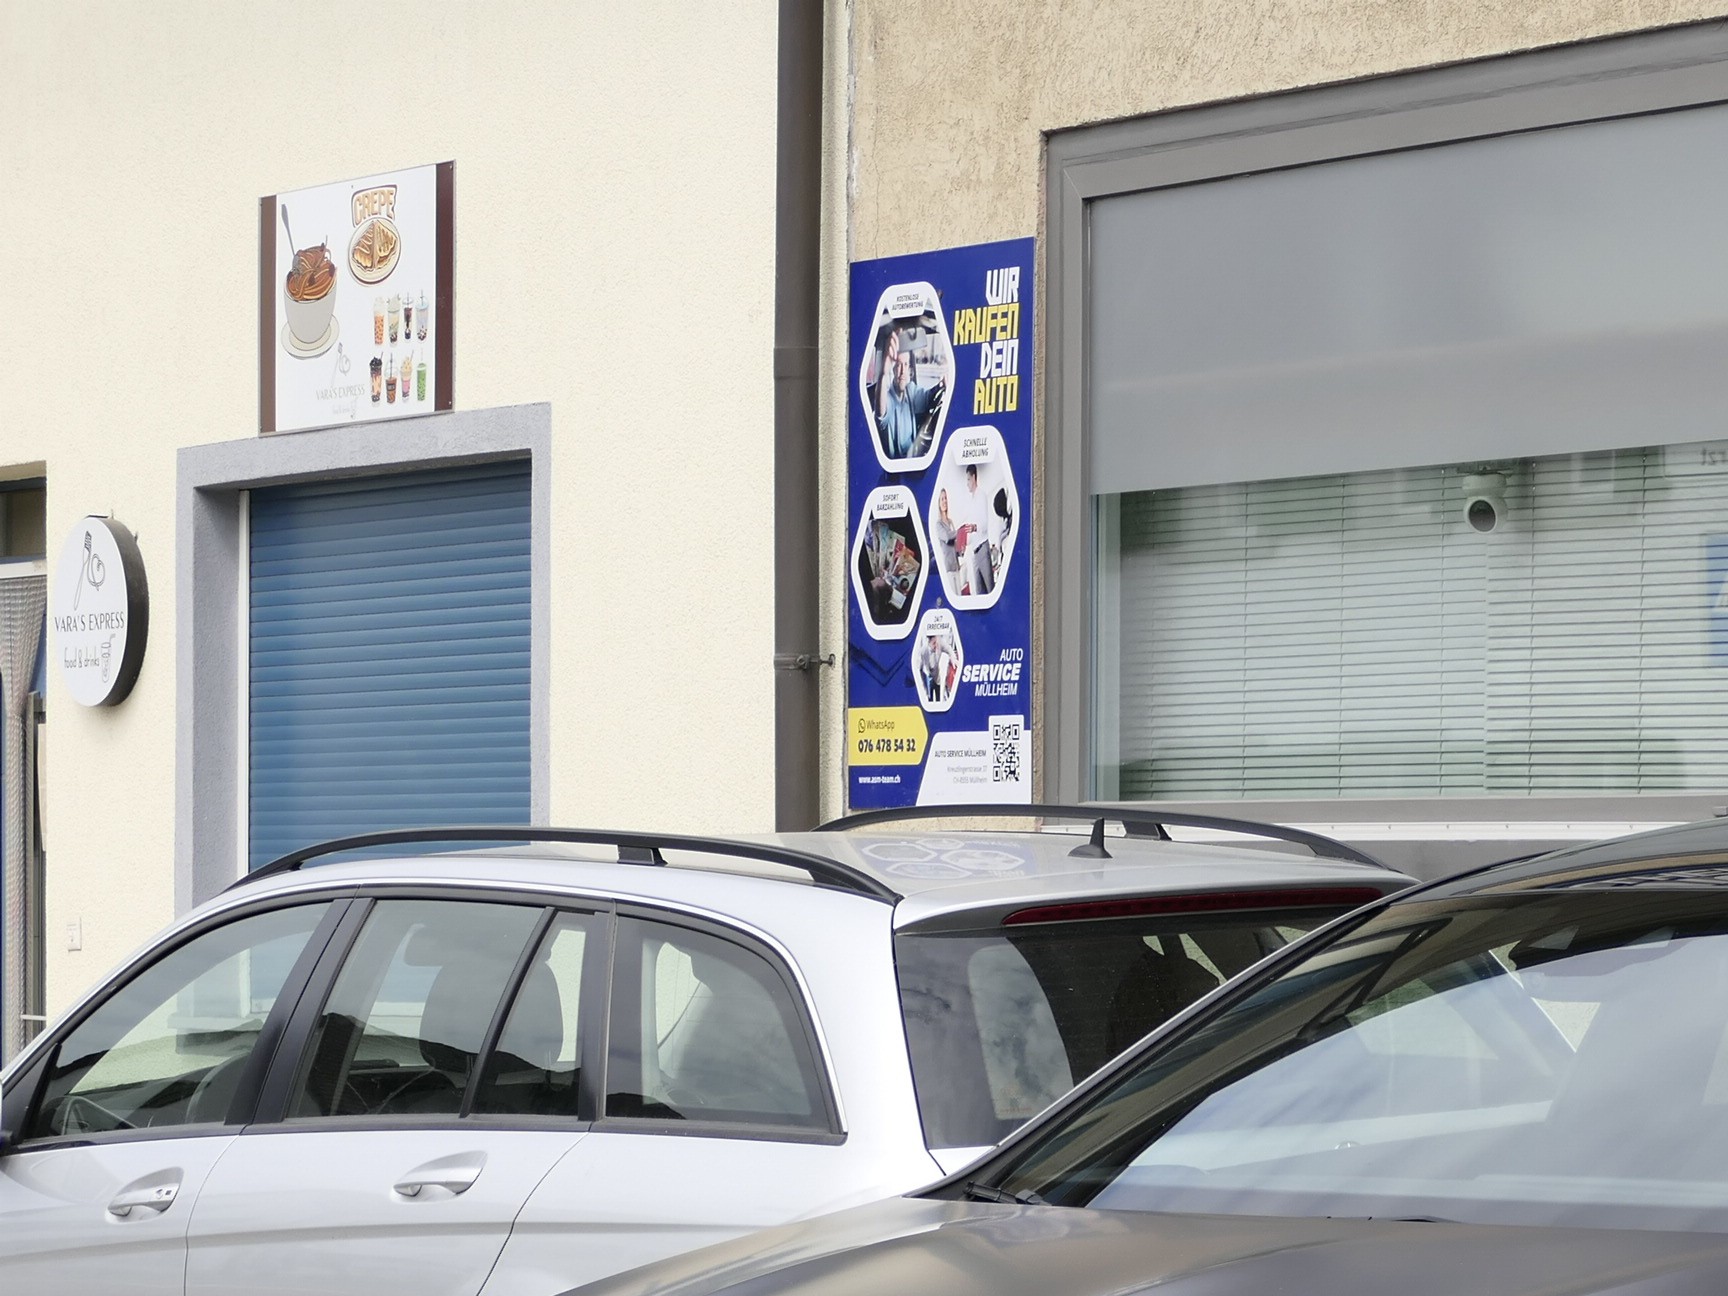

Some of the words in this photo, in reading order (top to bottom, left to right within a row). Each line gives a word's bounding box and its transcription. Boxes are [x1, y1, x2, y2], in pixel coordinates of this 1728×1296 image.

[354, 189, 395, 225] CREPE
[985, 266, 1020, 305] WIR
[953, 303, 1019, 346] KAUFEN
[980, 339, 1019, 378] DEIN
[973, 375, 1018, 415] AUTO
[55, 614, 86, 632] VARA'S
[89, 611, 125, 631] EXPRESS
[1000, 648, 1023, 661] AUTO
[962, 663, 1021, 682] SERVICE
[975, 682, 1018, 697] MÜLLHEIM
[867, 720, 895, 731] WhatsApp
[858, 739, 873, 752] 076
[876, 739, 891, 752] 478
[894, 739, 904, 752] 54
[906, 738, 916, 752] 32
